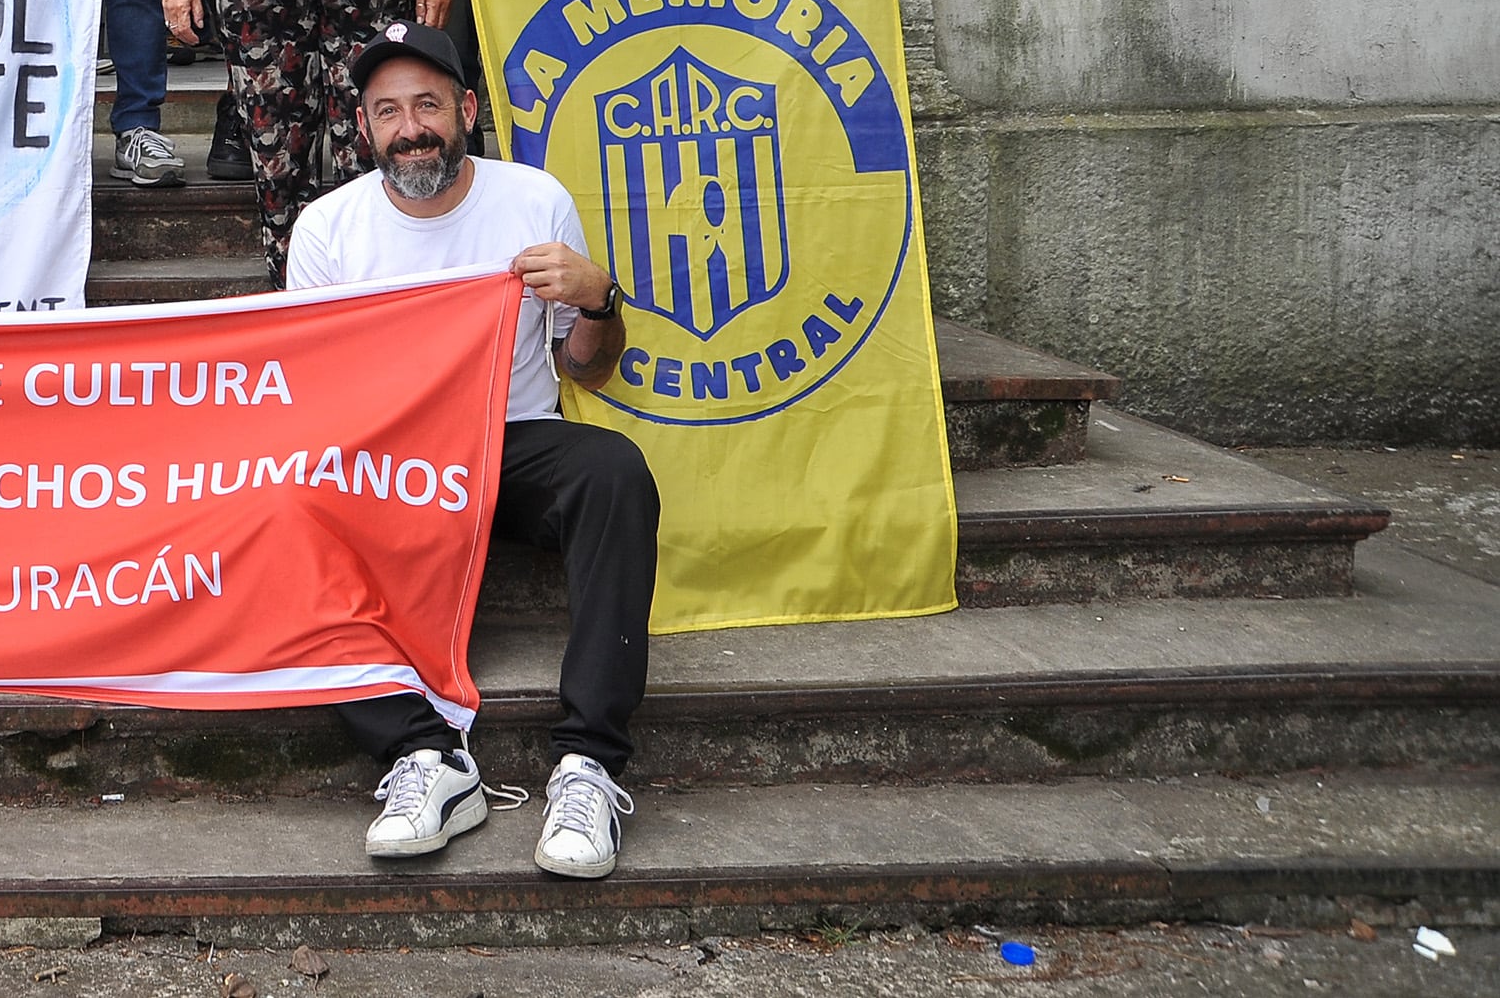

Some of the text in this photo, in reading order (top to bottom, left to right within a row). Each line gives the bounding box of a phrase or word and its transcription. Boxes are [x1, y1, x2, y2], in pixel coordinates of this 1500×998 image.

[512, 48, 568, 134] LA
[603, 62, 775, 138] C.A.R.C.
[23, 359, 294, 407] CULTURA
[620, 293, 864, 400] CENTRAL
[165, 445, 470, 513] HUMANOS
